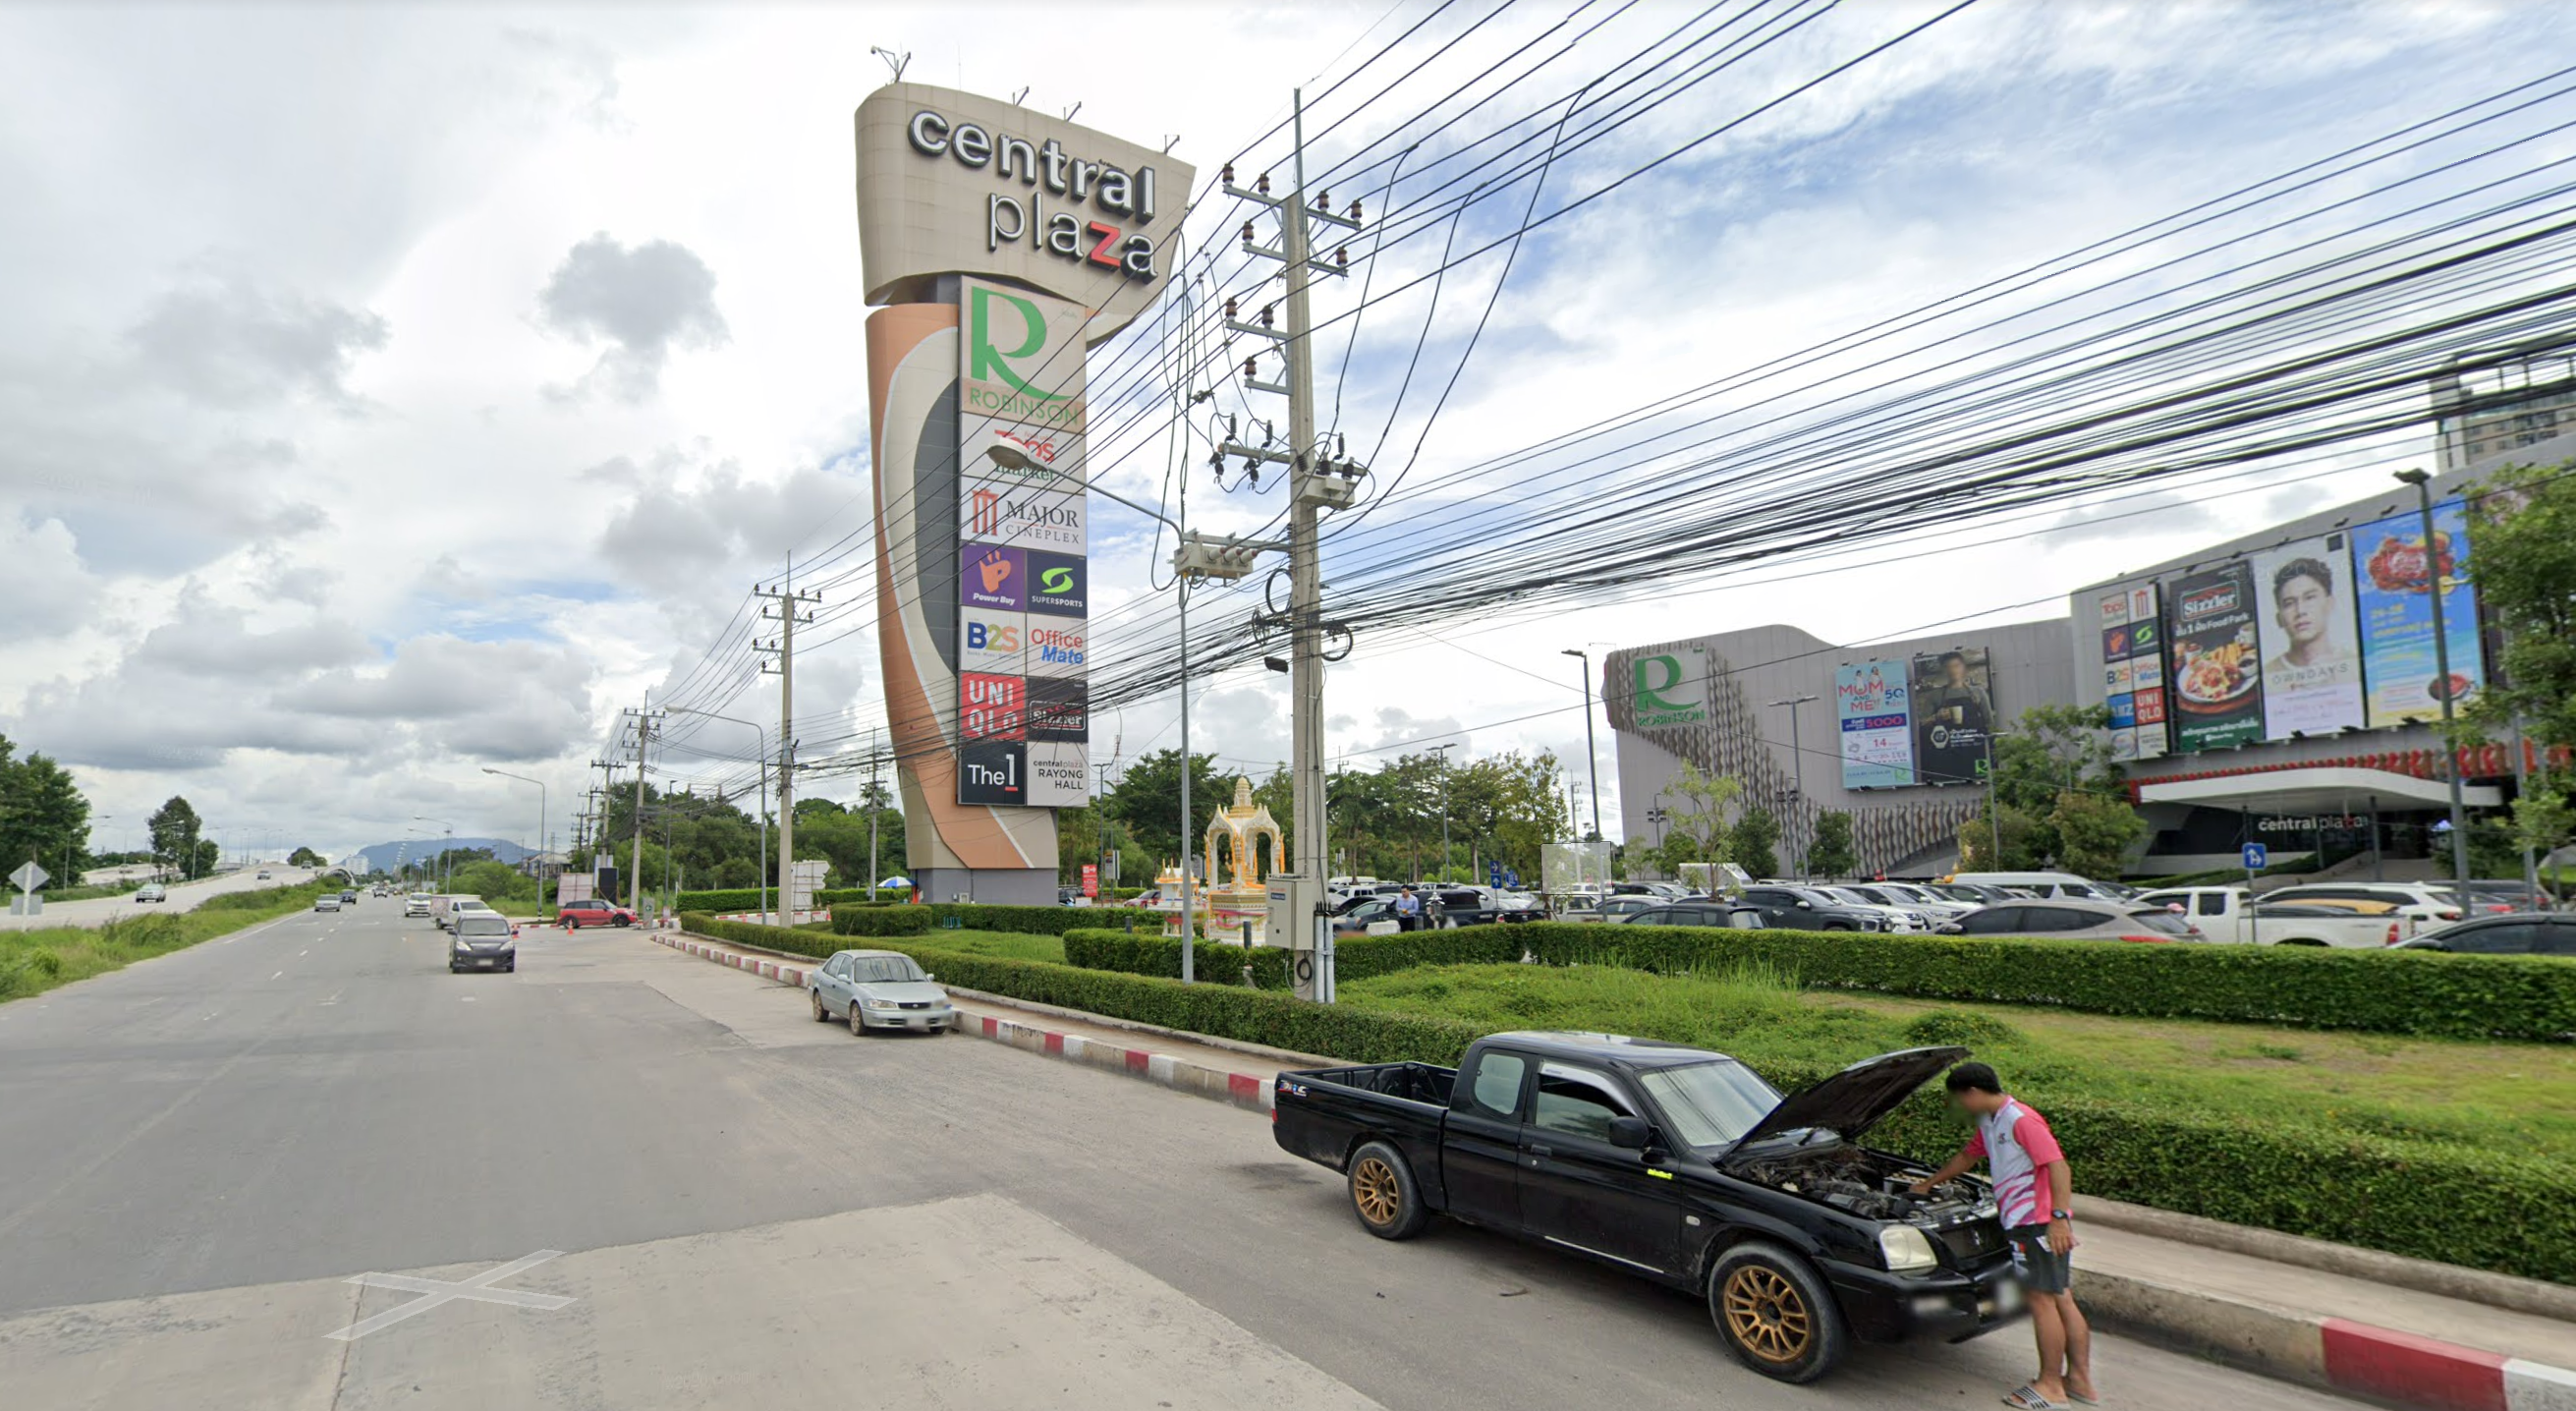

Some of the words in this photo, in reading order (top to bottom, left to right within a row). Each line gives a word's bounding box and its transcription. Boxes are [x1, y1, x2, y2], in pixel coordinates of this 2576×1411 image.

[908, 109, 1155, 225] central
[987, 191, 1159, 284] plaza
[970, 386, 1079, 425] ROBINSON
[1005, 500, 1080, 529] MAJOR
[1005, 524, 1080, 545] CINEPLEX
[973, 592, 1000, 604] Power
[1000, 594, 1016, 606] Buy
[1032, 595, 1084, 608] SUPERSPORTS
[2183, 593, 2236, 616] Sizzler
[968, 621, 1020, 652] B2S
[1031, 628, 1084, 649] Office
[1041, 645, 1085, 664] Mate
[2271, 662, 2349, 684] OWNDAYS
[969, 679, 1014, 707] UNI
[2137, 691, 2159, 708] UNI
[1638, 708, 1706, 726] ROBINSON
[2138, 706, 2162, 723] QLO
[1037, 768, 1084, 780] RAYONG
[1054, 779, 1084, 790] HALL
